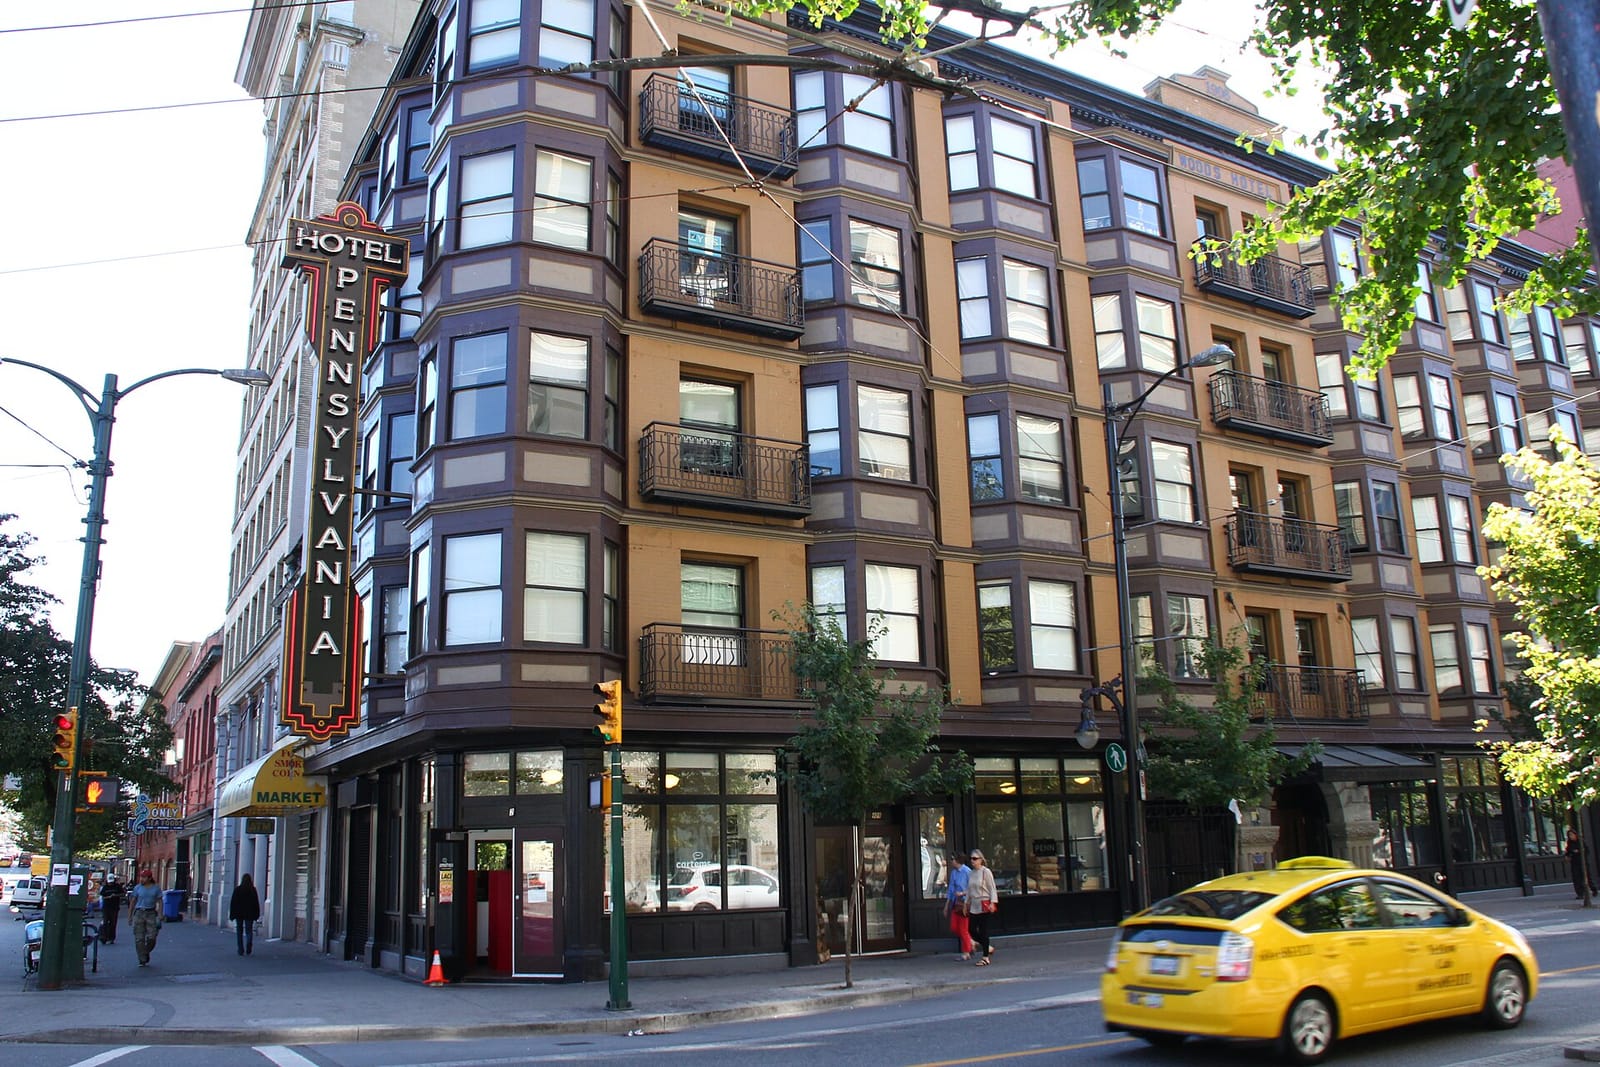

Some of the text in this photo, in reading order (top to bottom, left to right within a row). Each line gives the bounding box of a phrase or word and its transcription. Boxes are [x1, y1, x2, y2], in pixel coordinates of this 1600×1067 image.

[1179, 154, 1272, 200] WOODS HOTEL
[295, 226, 402, 265] HOTEL
[309, 266, 360, 656] PENNSYLVANIA
[151, 808, 178, 818] ONLY
[256, 791, 322, 803] MARKET
